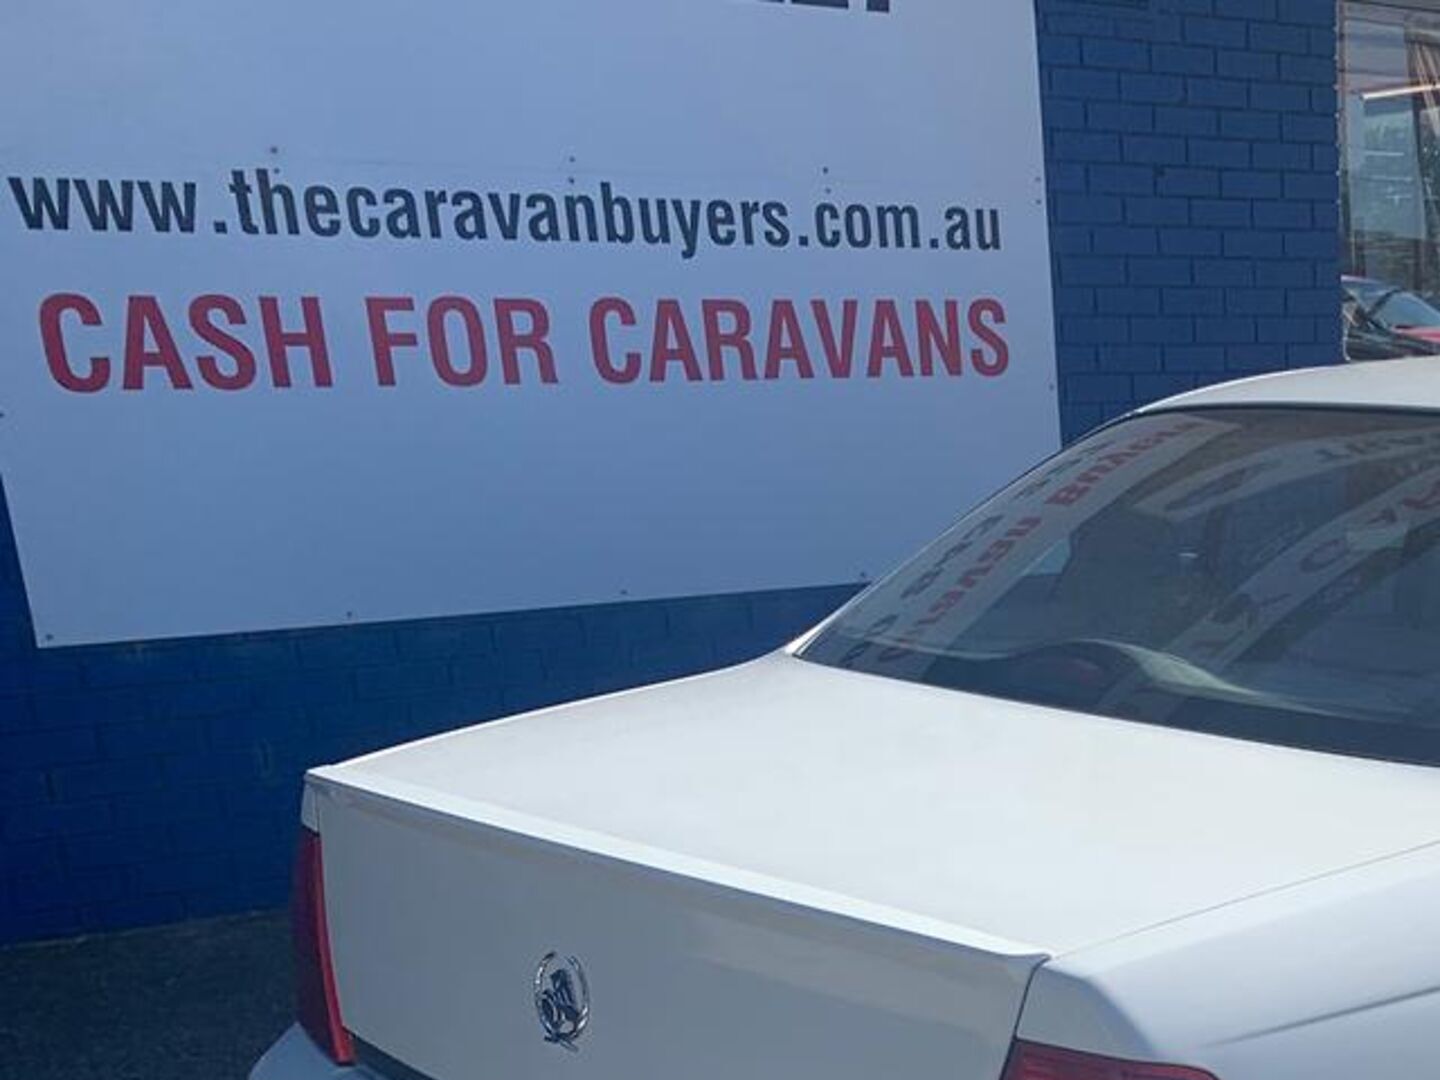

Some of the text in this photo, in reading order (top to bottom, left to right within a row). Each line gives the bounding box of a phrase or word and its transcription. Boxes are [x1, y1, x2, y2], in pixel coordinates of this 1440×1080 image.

[39, 293, 1009, 393] CASH FOR CARAVANS
